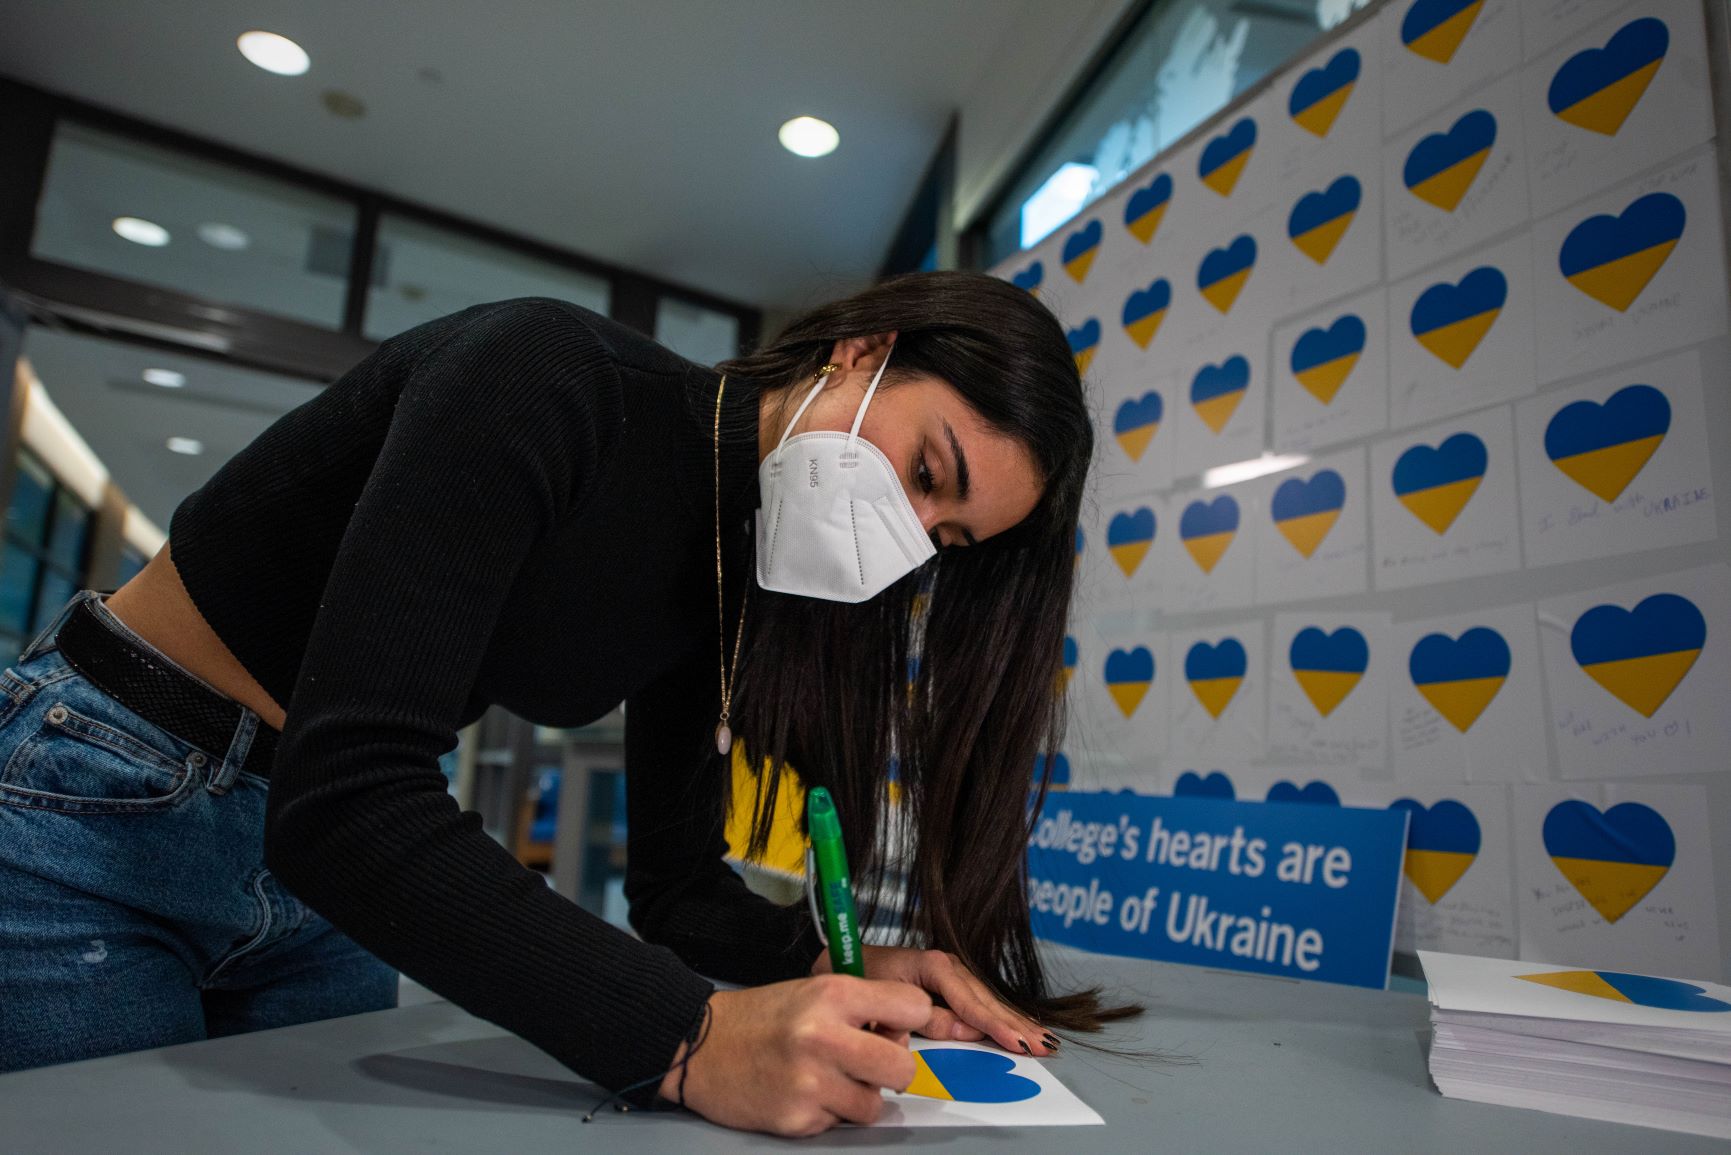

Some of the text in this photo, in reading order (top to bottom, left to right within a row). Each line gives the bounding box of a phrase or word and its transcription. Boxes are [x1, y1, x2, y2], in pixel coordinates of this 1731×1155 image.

[809, 459, 819, 488] KN95
[1147, 818, 1266, 878] hearts
[1276, 842, 1352, 889] are
[1119, 887, 1160, 934] of
[1166, 892, 1323, 971] Ukraine
